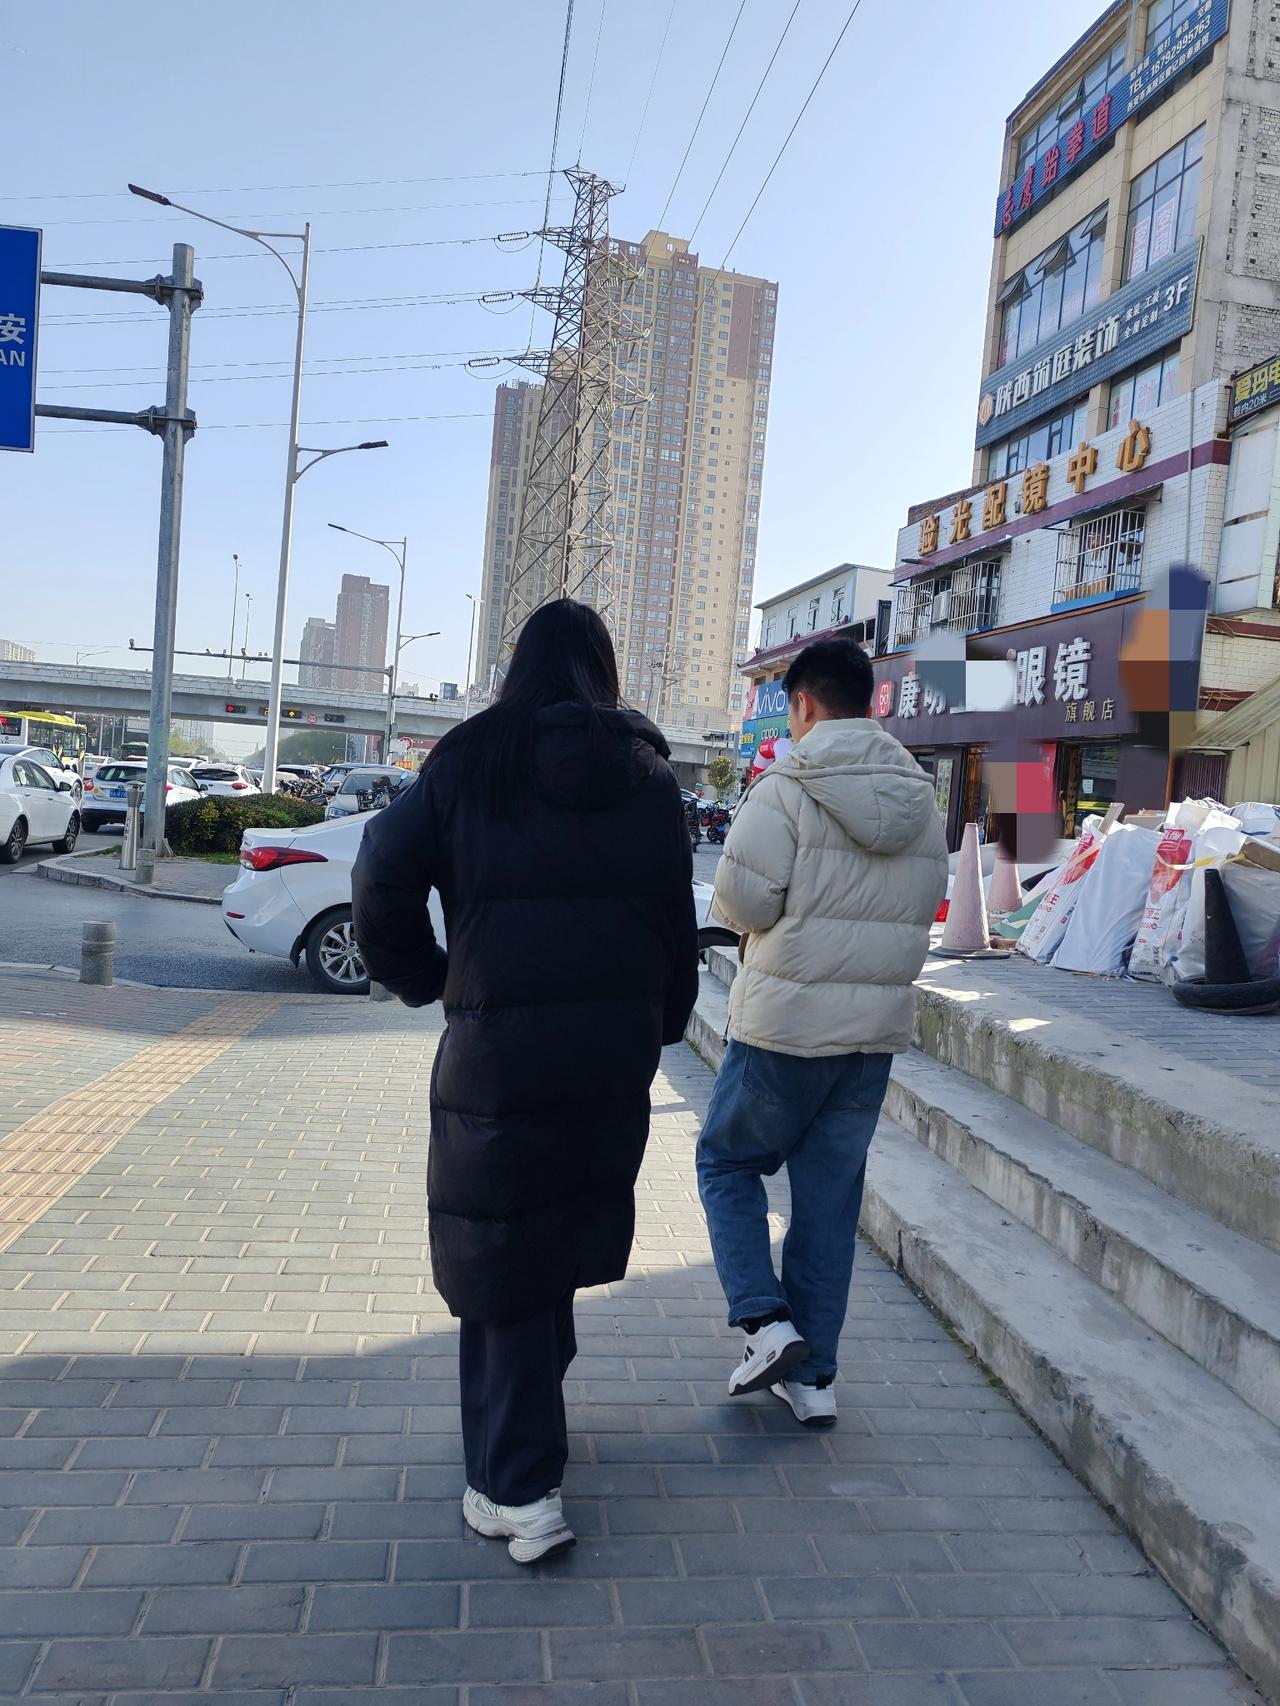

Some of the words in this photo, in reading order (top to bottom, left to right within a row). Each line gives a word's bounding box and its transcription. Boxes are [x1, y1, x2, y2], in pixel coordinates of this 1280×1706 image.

[1163, 275, 1188, 312] 3F
[0, 313, 26, 345] 安
[918, 418, 1151, 556] 验光配镜中心
[756, 686, 786, 715] vivo
[1065, 698, 1115, 723] 旗舰店
